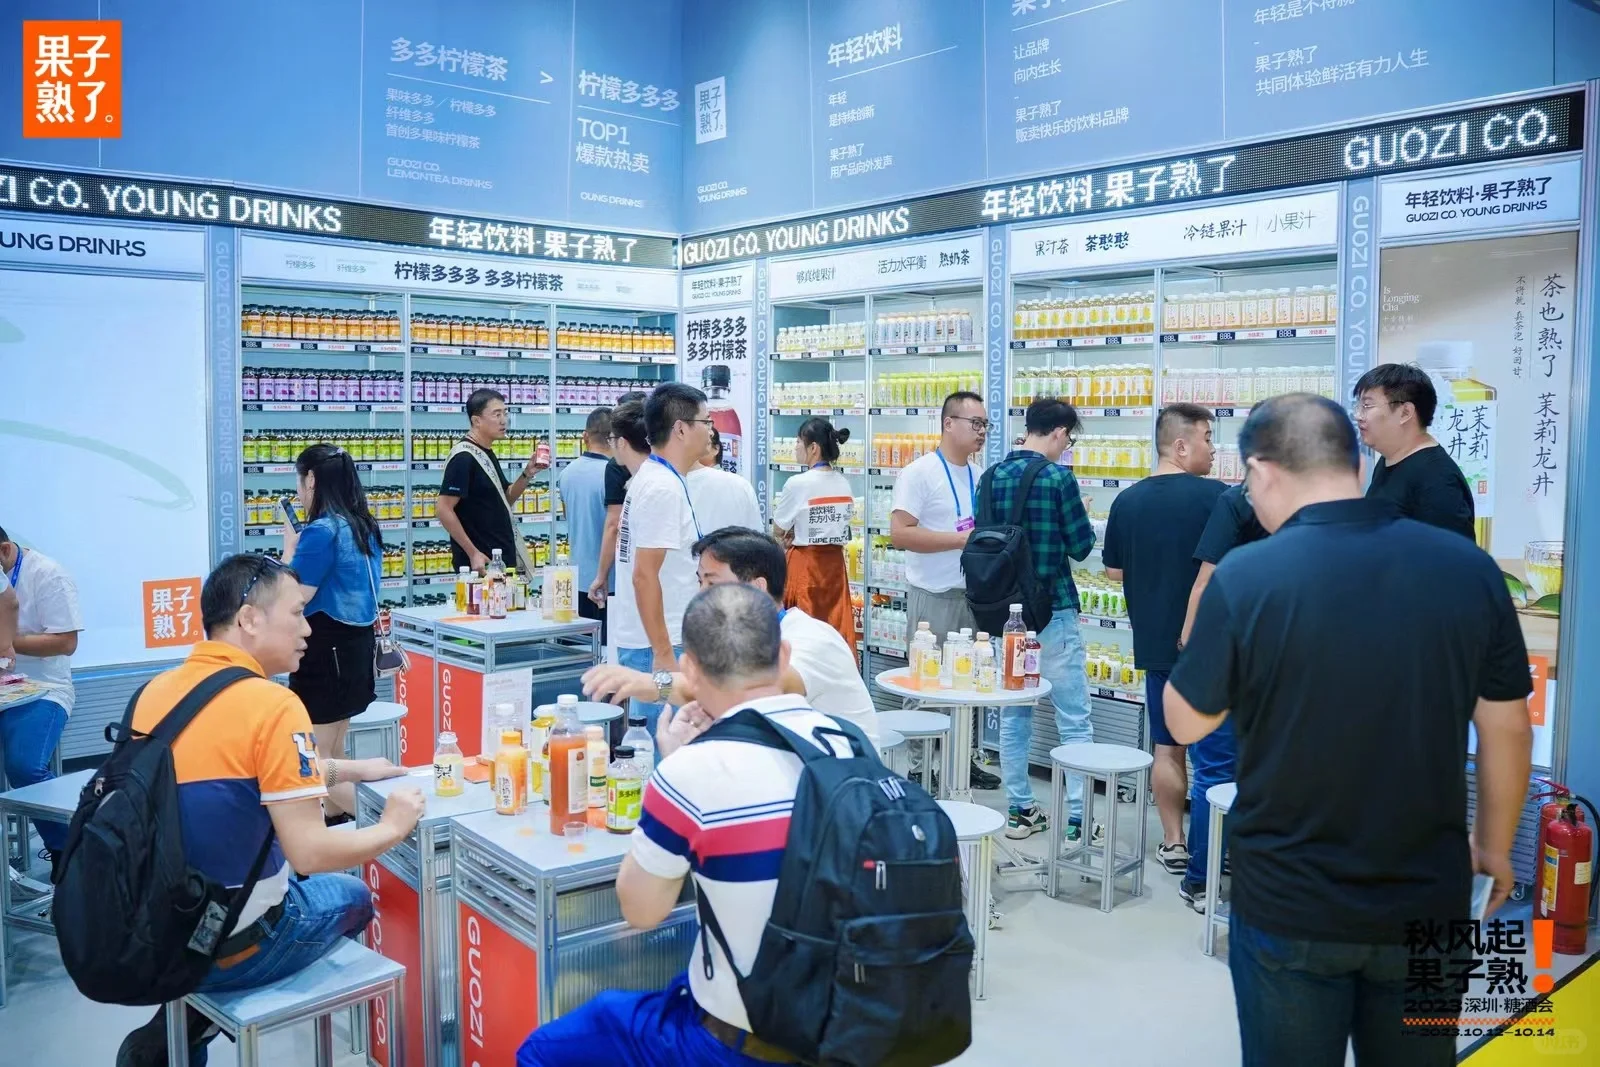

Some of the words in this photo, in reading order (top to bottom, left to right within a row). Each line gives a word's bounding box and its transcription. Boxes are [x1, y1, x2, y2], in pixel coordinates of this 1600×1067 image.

[391, 37, 509, 82] 多多柠檬茶
[828, 23, 903, 67] 年轻饮料
[1013, 38, 1049, 60] 让品牌
[1255, 45, 1318, 73] 果子熟了
[1014, 58, 1061, 84] 向内生长
[1255, 48, 1430, 96] 共同体验鲜活有力人生
[386, 87, 435, 108] 果味多多
[450, 98, 497, 118] 柠檬多多
[578, 69, 681, 112] 柠檬多多多
[700, 85, 722, 112] 果子
[828, 91, 848, 107] 年轻
[386, 106, 434, 125] 纤维多多
[829, 104, 876, 128] 是持续创新
[1015, 100, 1061, 123] 果子熟了
[1015, 106, 1129, 143] 贩卖快乐的饮料品牌
[385, 123, 481, 150] 首创多果味柠檬茶
[577, 117, 631, 147] TOP1
[1344, 122, 1468, 171] GUOZI
[1483, 108, 1558, 153] CO.
[387, 157, 422, 169] GUOZI
[423, 162, 441, 173] CO.
[576, 142, 650, 176] 爆款热卖
[830, 143, 865, 163] 果子熟了
[830, 155, 894, 179] 用产品向外发声
[387, 168, 450, 185] LEMONTEA
[451, 176, 493, 190] DRINKS
[981, 155, 1237, 221] 年轻饮料·果子熟了
[1404, 177, 1553, 209] 年轻饮料·果子熟了
[29, 176, 89, 209] CO.
[100, 184, 220, 219] YOUNG
[229, 195, 342, 234] DRINKS
[608, 196, 646, 210] DRINKS
[1405, 211, 1439, 223] GUOZI
[1440, 208, 1458, 221] CO.
[1460, 204, 1501, 219] YOUNG
[1502, 199, 1548, 214] DRINKS
[683, 236, 730, 267] GUOZI
[732, 232, 761, 260] CO.
[764, 218, 830, 256] YOUNG
[832, 206, 910, 248] DRINKS
[1183, 219, 1248, 242] 冷链果汁
[1267, 211, 1317, 235] 小果汁
[1350, 195, 1369, 269] GUOZI
[0, 231, 53, 252] UNG
[59, 236, 146, 257] DRINKS
[428, 216, 637, 263] 年轻饮料·果子熟了
[1033, 239, 1069, 259] 果汁茶
[1084, 231, 1131, 256] 茶憨憨
[394, 260, 481, 288] 柠檬多多多
[484, 269, 564, 293] 多多柠檬茶
[878, 255, 928, 275] 活力水平衡
[990, 239, 1002, 297] GUOZI
[757, 268, 767, 315] GUOZI
[1349, 275, 1368, 312] CO.
[1382, 293, 1420, 305] Longjing
[1382, 303, 1399, 312] Cha
[687, 316, 747, 341] 柠檬多多多
[1537, 273, 1566, 378] 茶也熟了
[687, 338, 748, 362] 多多柠檬茶
[757, 347, 768, 401] YOUNG
[989, 335, 1001, 403] YOUNG
[757, 406, 769, 466] DRINKS
[1446, 409, 1468, 460] 龙井
[1468, 405, 1491, 459] 茉莉
[1531, 392, 1561, 497] 茉莉龙井
[218, 490, 233, 547] GUOZI
[809, 513, 842, 524] 东方小果子
[151, 586, 195, 614] 果子
[153, 612, 198, 642] 熟了。
[442, 668, 452, 732] GUOZ
[467, 915, 484, 1049] GUOZI
